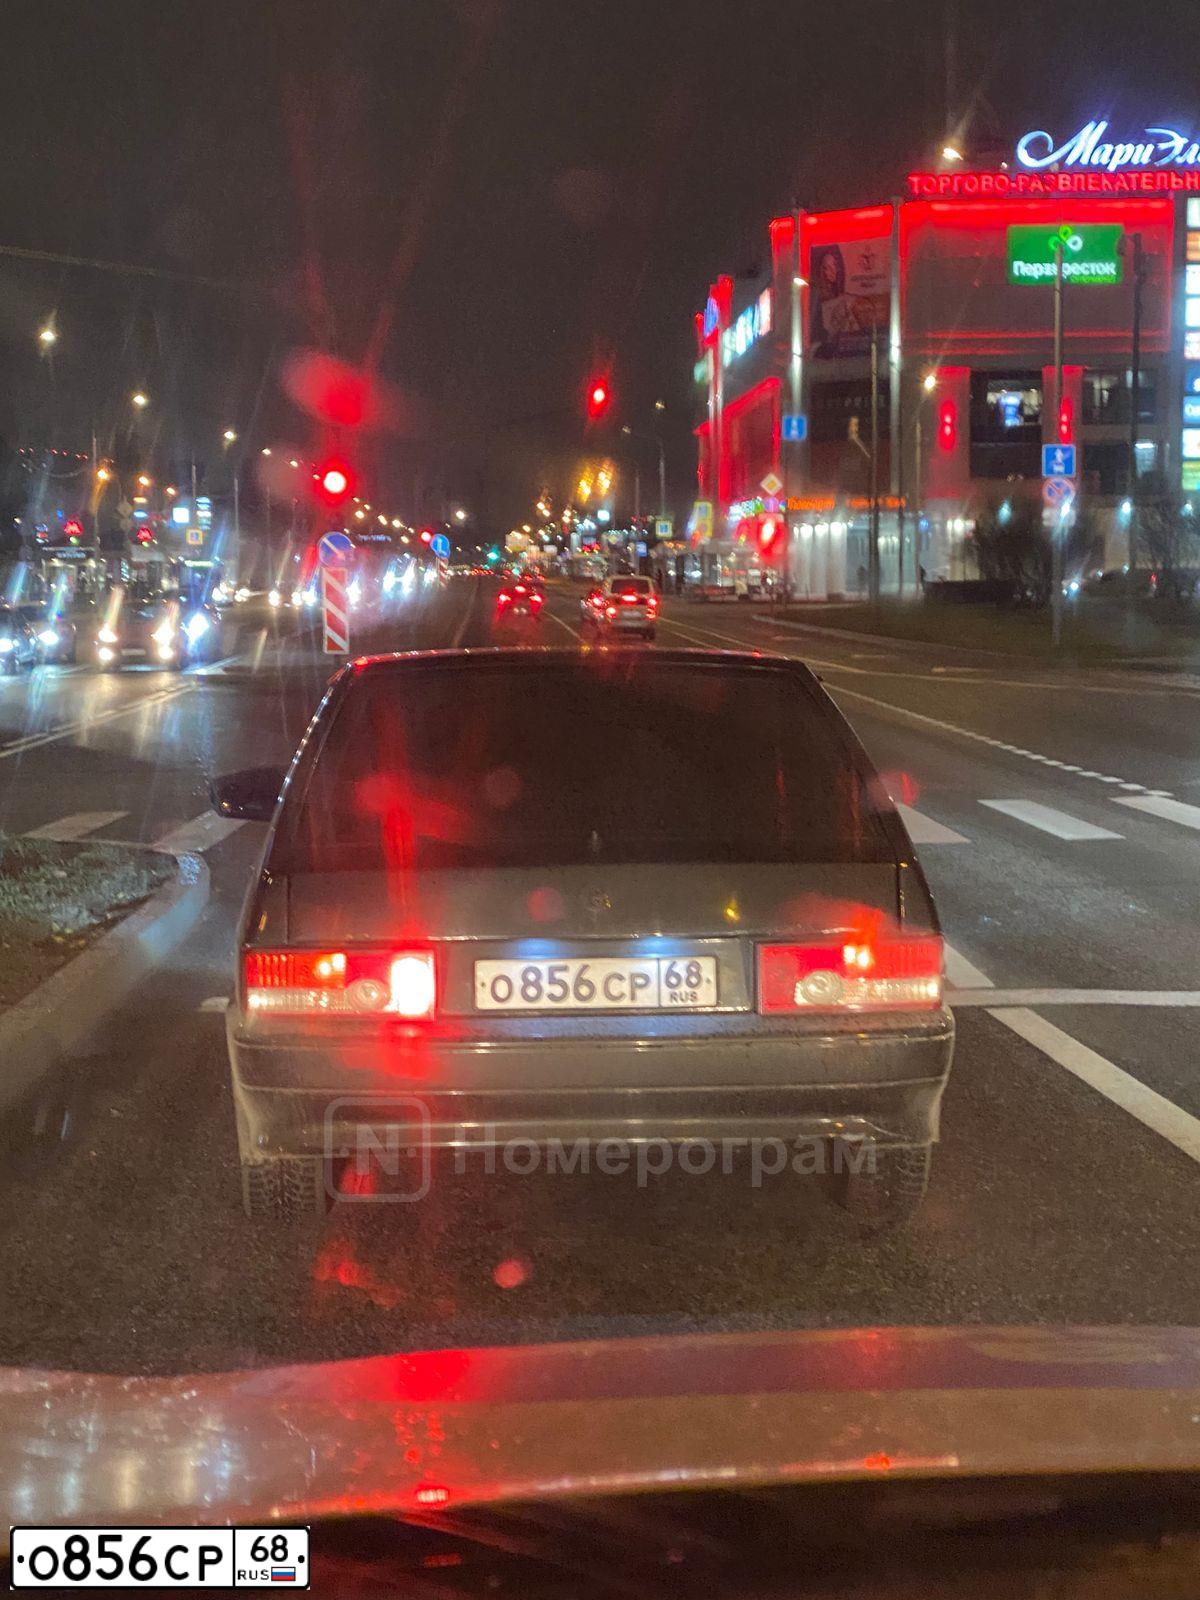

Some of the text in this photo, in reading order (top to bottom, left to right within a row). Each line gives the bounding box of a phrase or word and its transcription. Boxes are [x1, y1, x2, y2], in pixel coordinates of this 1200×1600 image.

[490, 959, 703, 1003] О856СР 68
[669, 991, 699, 1004] RUS
